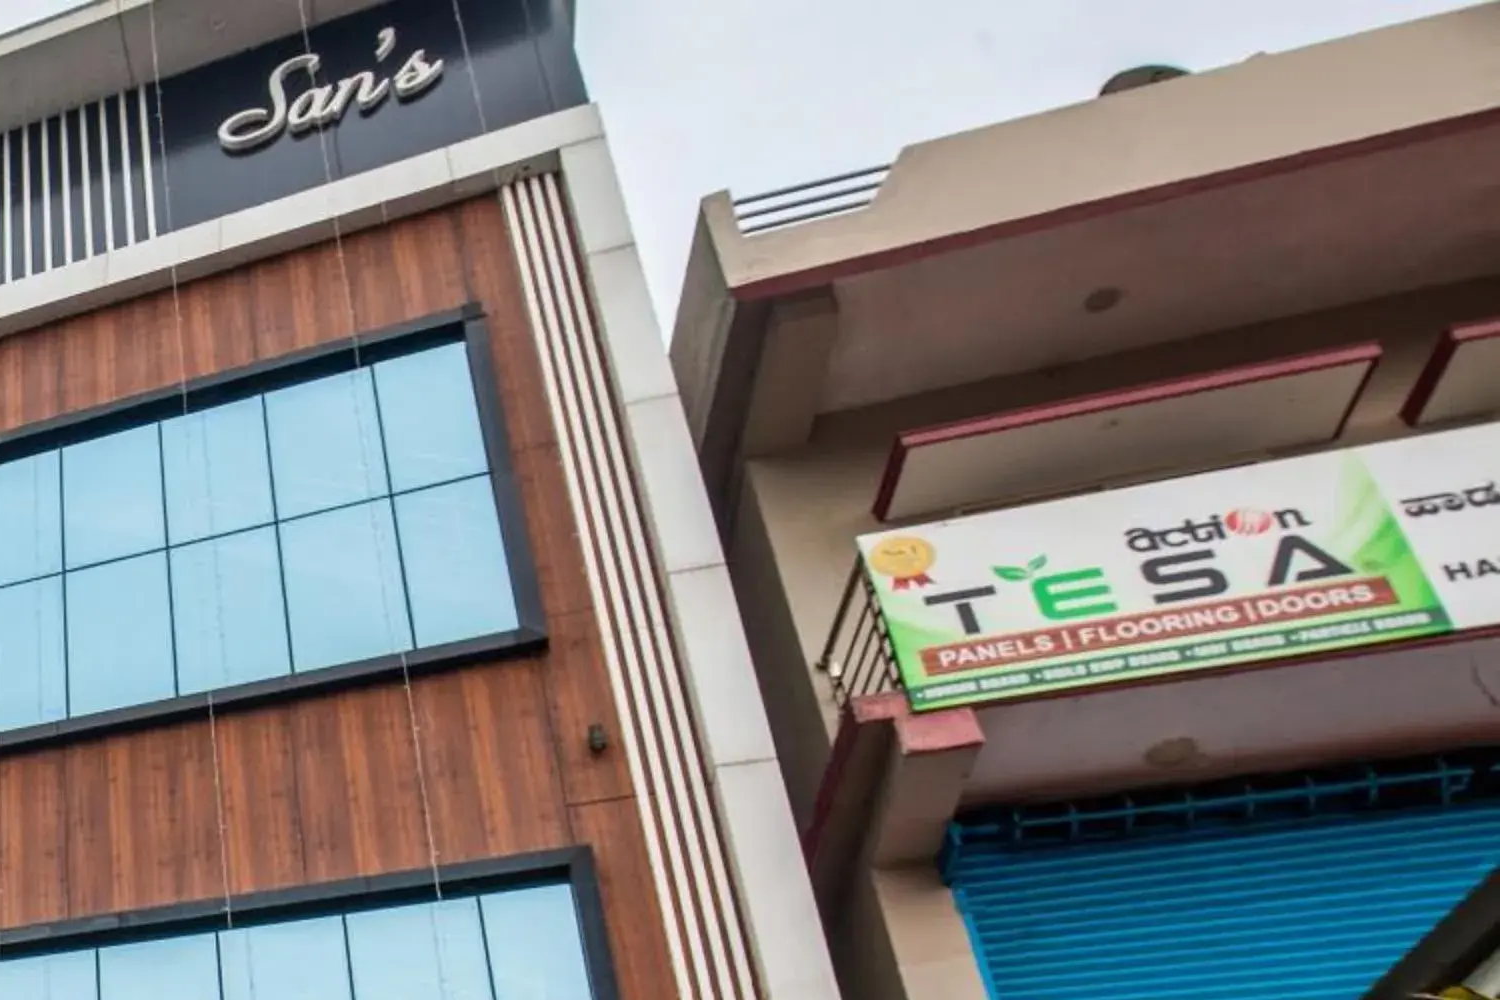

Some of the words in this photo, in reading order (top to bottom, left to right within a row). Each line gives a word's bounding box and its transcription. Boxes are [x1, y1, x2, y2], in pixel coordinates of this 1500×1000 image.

[217, 26, 444, 149] San's
[924, 534, 1356, 636] TESA
[1443, 555, 1500, 582] HA
[938, 634, 1055, 668] PANELS
[1079, 605, 1239, 645] FLOORING
[1257, 585, 1375, 617] DOORS
